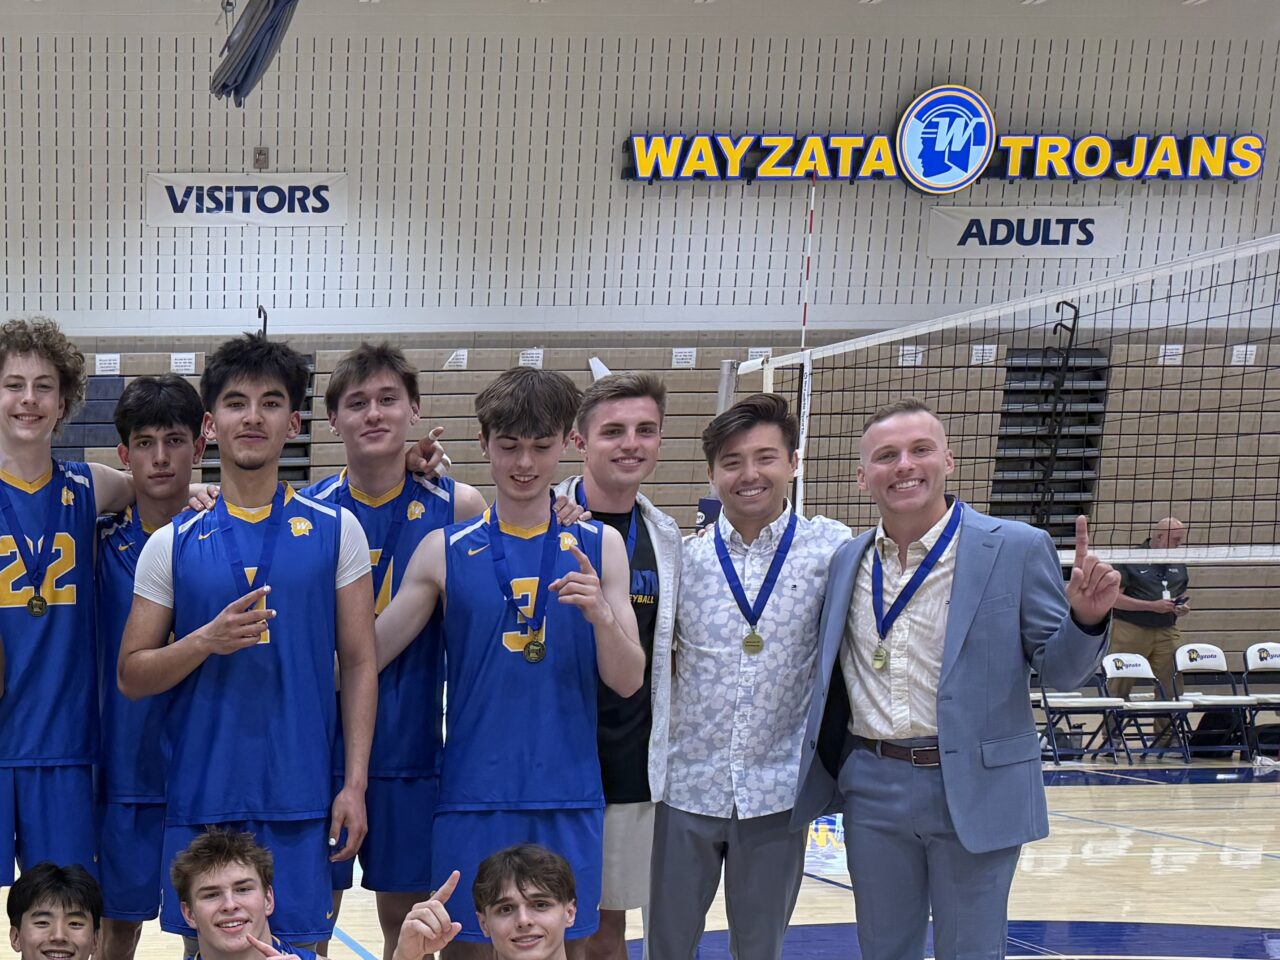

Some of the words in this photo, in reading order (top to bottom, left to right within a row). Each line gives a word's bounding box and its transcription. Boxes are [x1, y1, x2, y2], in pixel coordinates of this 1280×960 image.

[631, 135, 898, 179] WAYZATA
[1000, 134, 1265, 179] TROJANS
[164, 184, 330, 214] VISITORS
[957, 217, 1095, 246] ADULTS
[502, 576, 547, 653] 3
